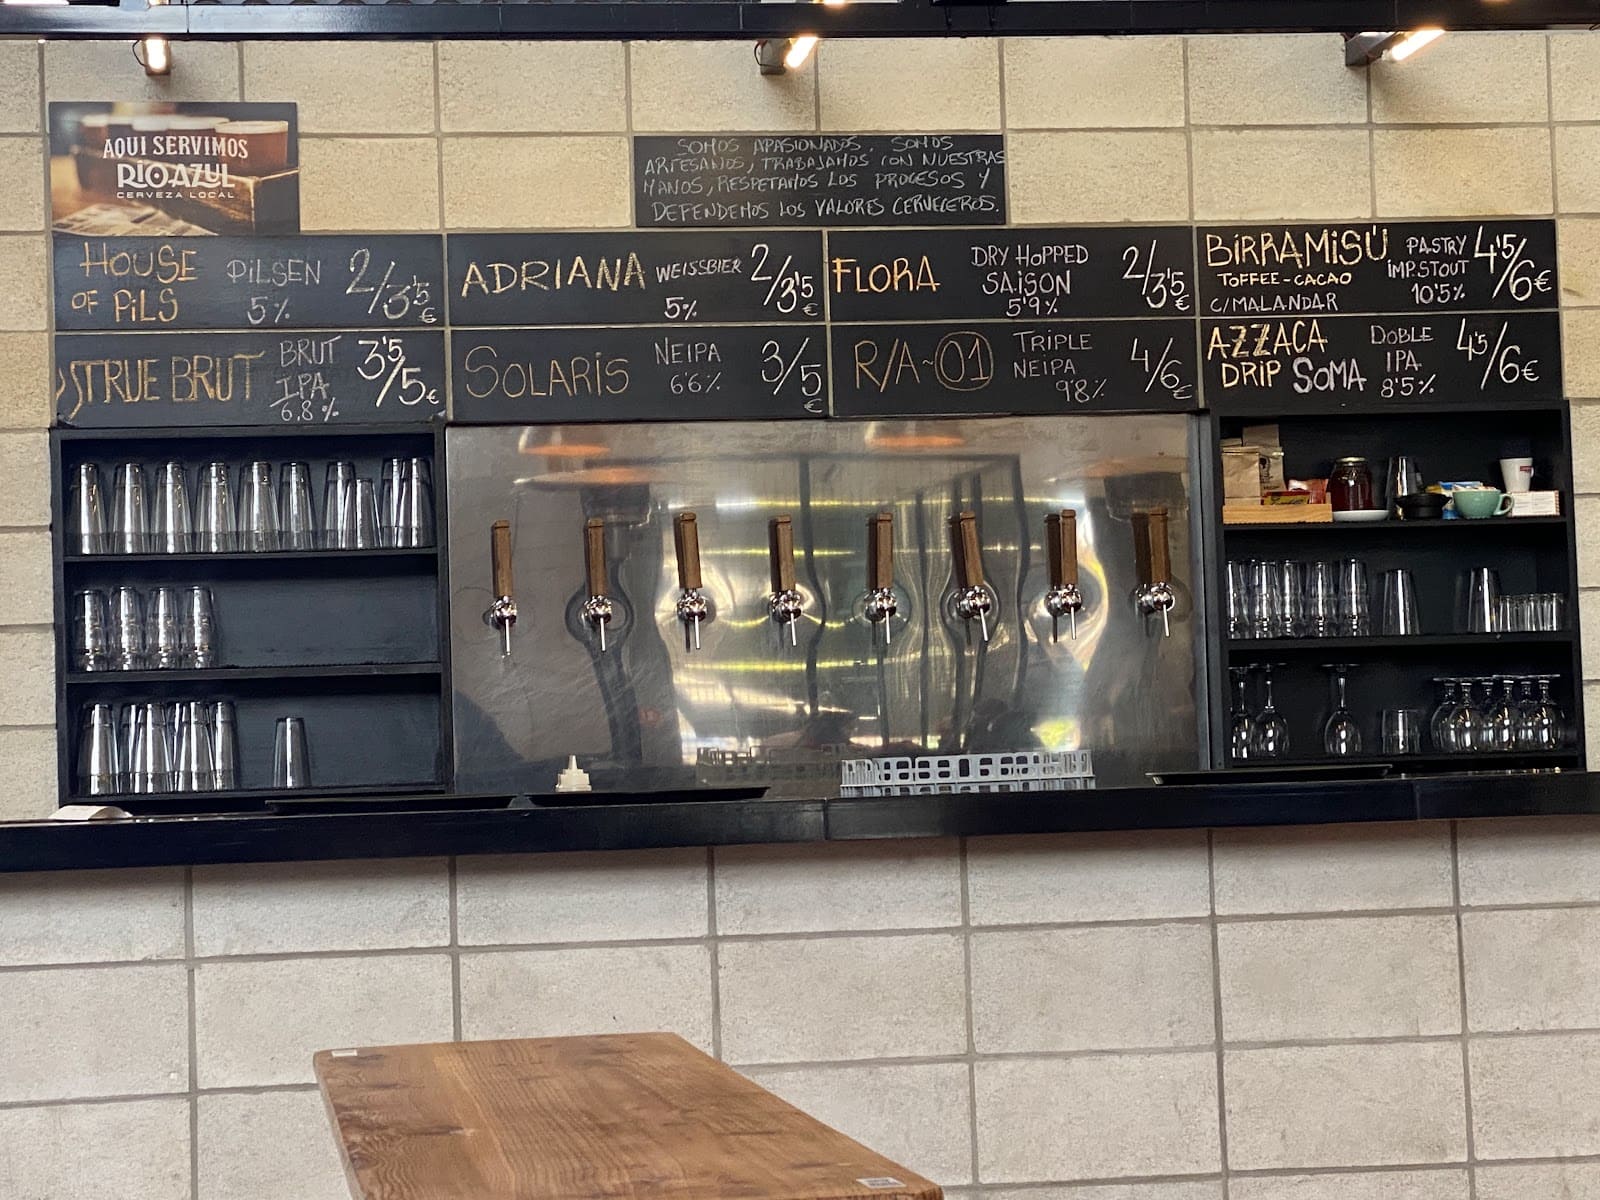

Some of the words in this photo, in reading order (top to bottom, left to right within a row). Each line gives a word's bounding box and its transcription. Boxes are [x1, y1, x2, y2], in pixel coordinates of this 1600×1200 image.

[103, 136, 147, 158] AQUI
[153, 135, 249, 158] SERVIMOS
[828, 171, 858, 187] LOS
[875, 170, 966, 190] PROCESOS
[979, 167, 991, 190] Y
[117, 191, 183, 199] CERVEZA
[189, 191, 235, 199] LOCAL
[651, 200, 769, 222] DEFENDEMOS
[779, 201, 807, 218] LOS
[815, 199, 885, 217] VALORES
[971, 246, 1008, 267] DRY
[1406, 235, 1467, 256] PASTRY
[80, 241, 199, 284] HOUSE
[461, 252, 646, 298] ADRIANA
[655, 257, 743, 284] WEISSBIER
[832, 255, 941, 294] FLORA
[71, 290, 98, 315] OF
[246, 296, 291, 325] 5%
[664, 296, 698, 321] 5%
[1013, 330, 1093, 352] TRIPLE
[1207, 319, 1328, 361] AZZACA
[1371, 325, 1434, 345] DOBLE
[280, 335, 342, 368] BRUT
[654, 337, 722, 365] NEIPA
[1386, 350, 1422, 373] IPA
[171, 351, 265, 403] BRUT
[464, 345, 629, 397] SOLARIS
[1013, 354, 1076, 379] NEIPA
